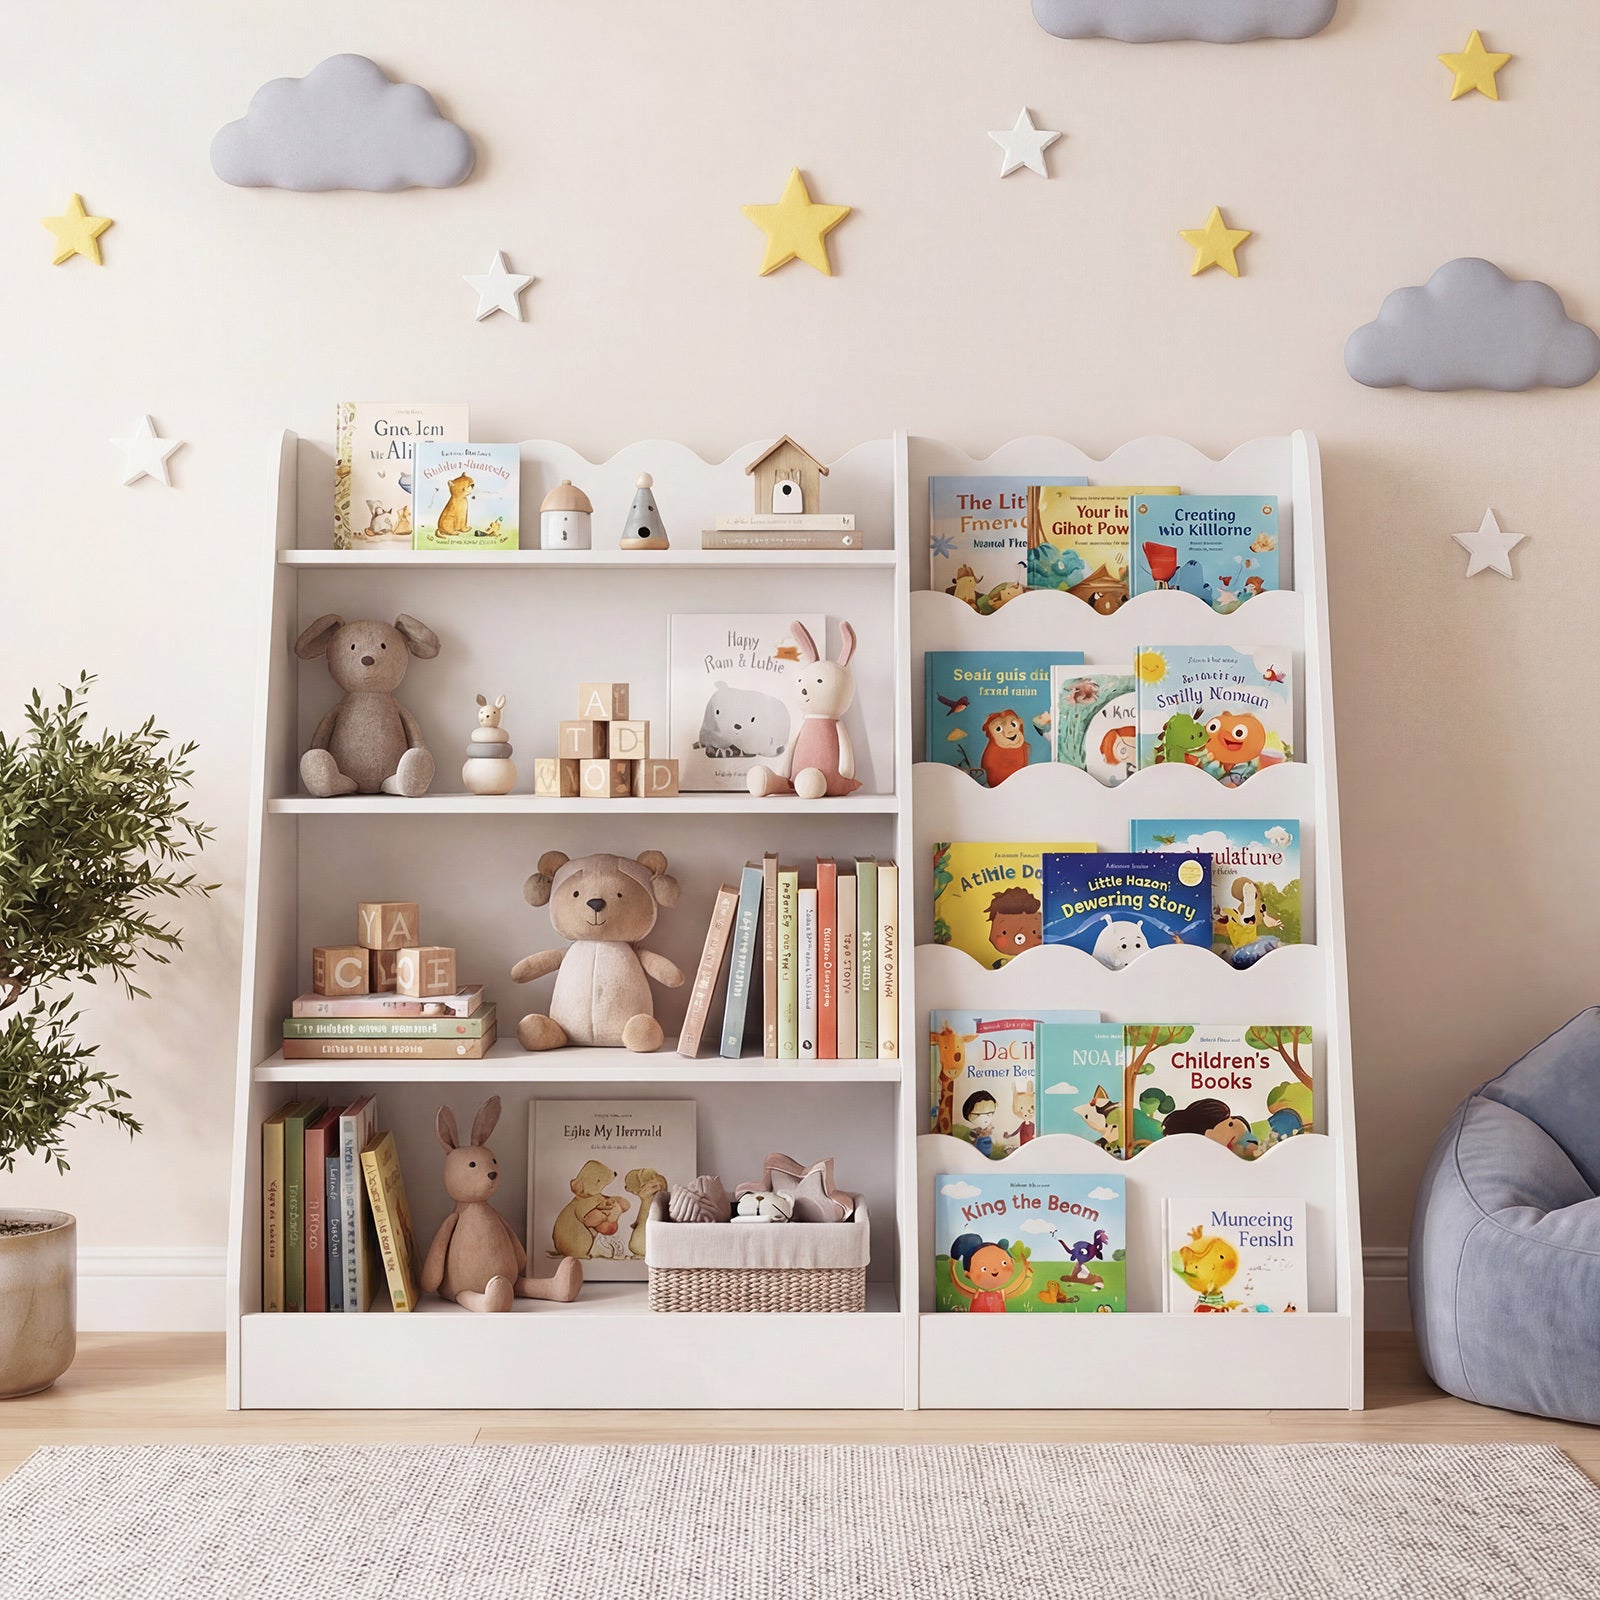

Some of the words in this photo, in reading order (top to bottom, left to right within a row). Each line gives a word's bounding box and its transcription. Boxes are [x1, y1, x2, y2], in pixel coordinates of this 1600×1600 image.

[956, 493, 993, 511] The
[999, 493, 1028, 510] Lit
[1076, 504, 1110, 519] Your
[1174, 508, 1236, 525] Creating
[1051, 520, 1094, 536] Gihot
[1097, 521, 1129, 536] Pow
[583, 689, 608, 717] A
[566, 727, 586, 753] T
[618, 727, 639, 753] D
[584, 764, 606, 791] O
[652, 765, 672, 791] D
[1087, 875, 1123, 892] Little
[1060, 890, 1144, 919] Dewering
[1148, 894, 1197, 922] Story
[334, 956, 363, 989] C
[1171, 1051, 1270, 1069] Children's
[1191, 1071, 1252, 1090] Books
[594, 1123, 613, 1141] My
[961, 1200, 1007, 1222] King
[1011, 1193, 1042, 1210] the
[1047, 1194, 1100, 1223] Beam
